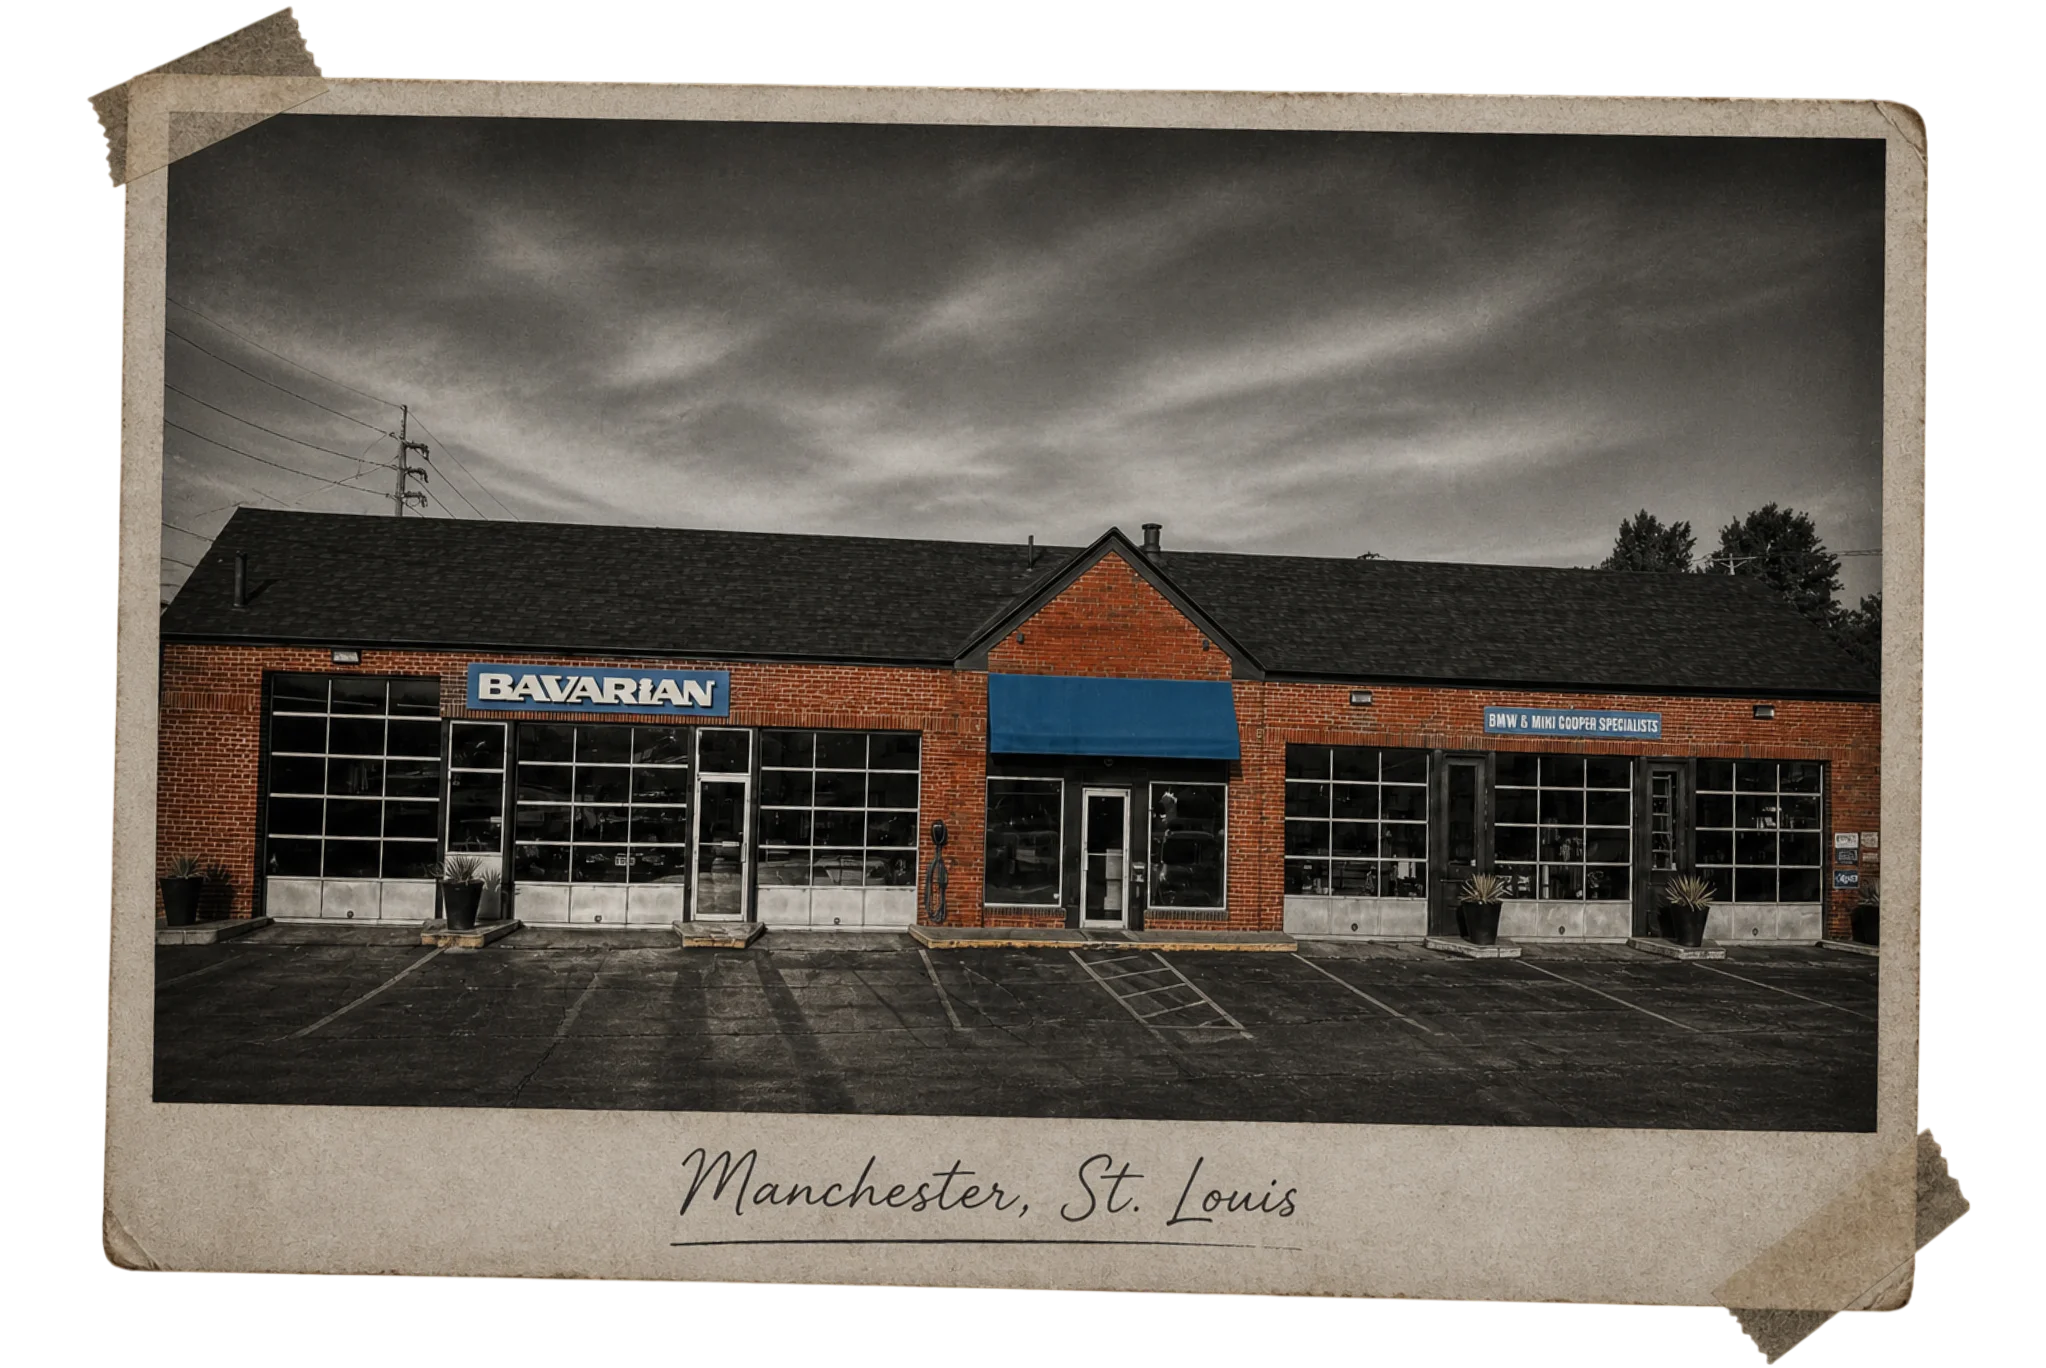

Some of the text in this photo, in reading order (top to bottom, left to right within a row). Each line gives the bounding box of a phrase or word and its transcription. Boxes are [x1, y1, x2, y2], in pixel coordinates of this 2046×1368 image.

[478, 672, 716, 707] BAVARIAN
[1488, 713, 1518, 728] BMW
[1520, 714, 1529, 729] &
[1558, 715, 1597, 731] COOPER
[1598, 717, 1659, 733] SPECIALISTS
